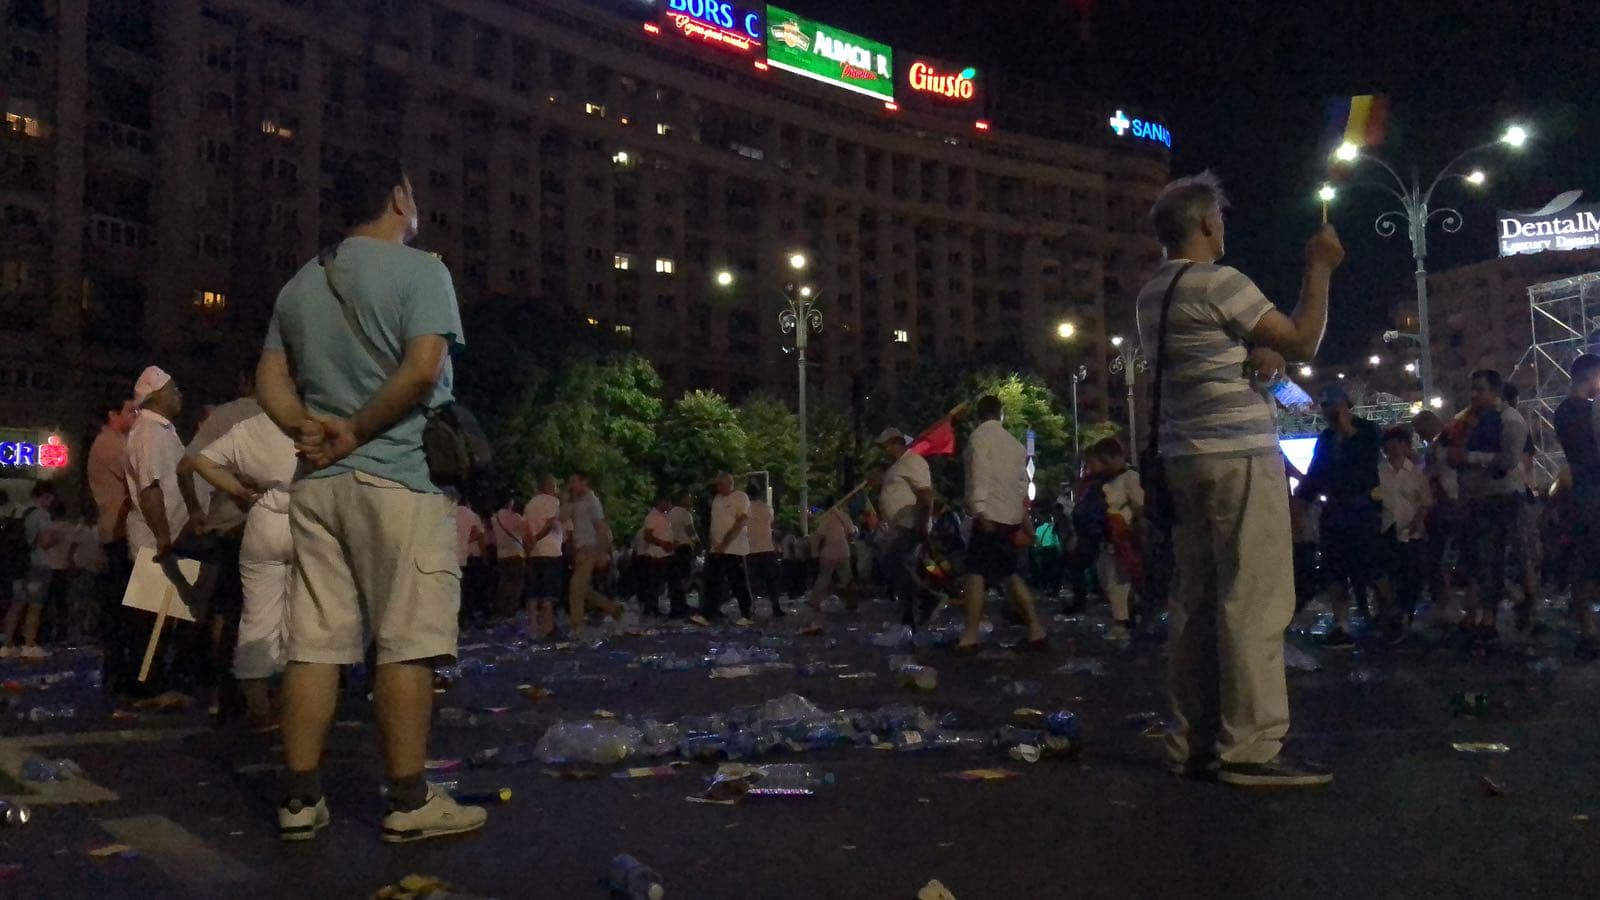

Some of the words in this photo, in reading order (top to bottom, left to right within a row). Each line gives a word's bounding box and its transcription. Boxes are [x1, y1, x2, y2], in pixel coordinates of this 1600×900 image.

[669, 0, 759, 38] ORSC
[909, 62, 974, 98] Giusto
[0, 441, 35, 466] CR
